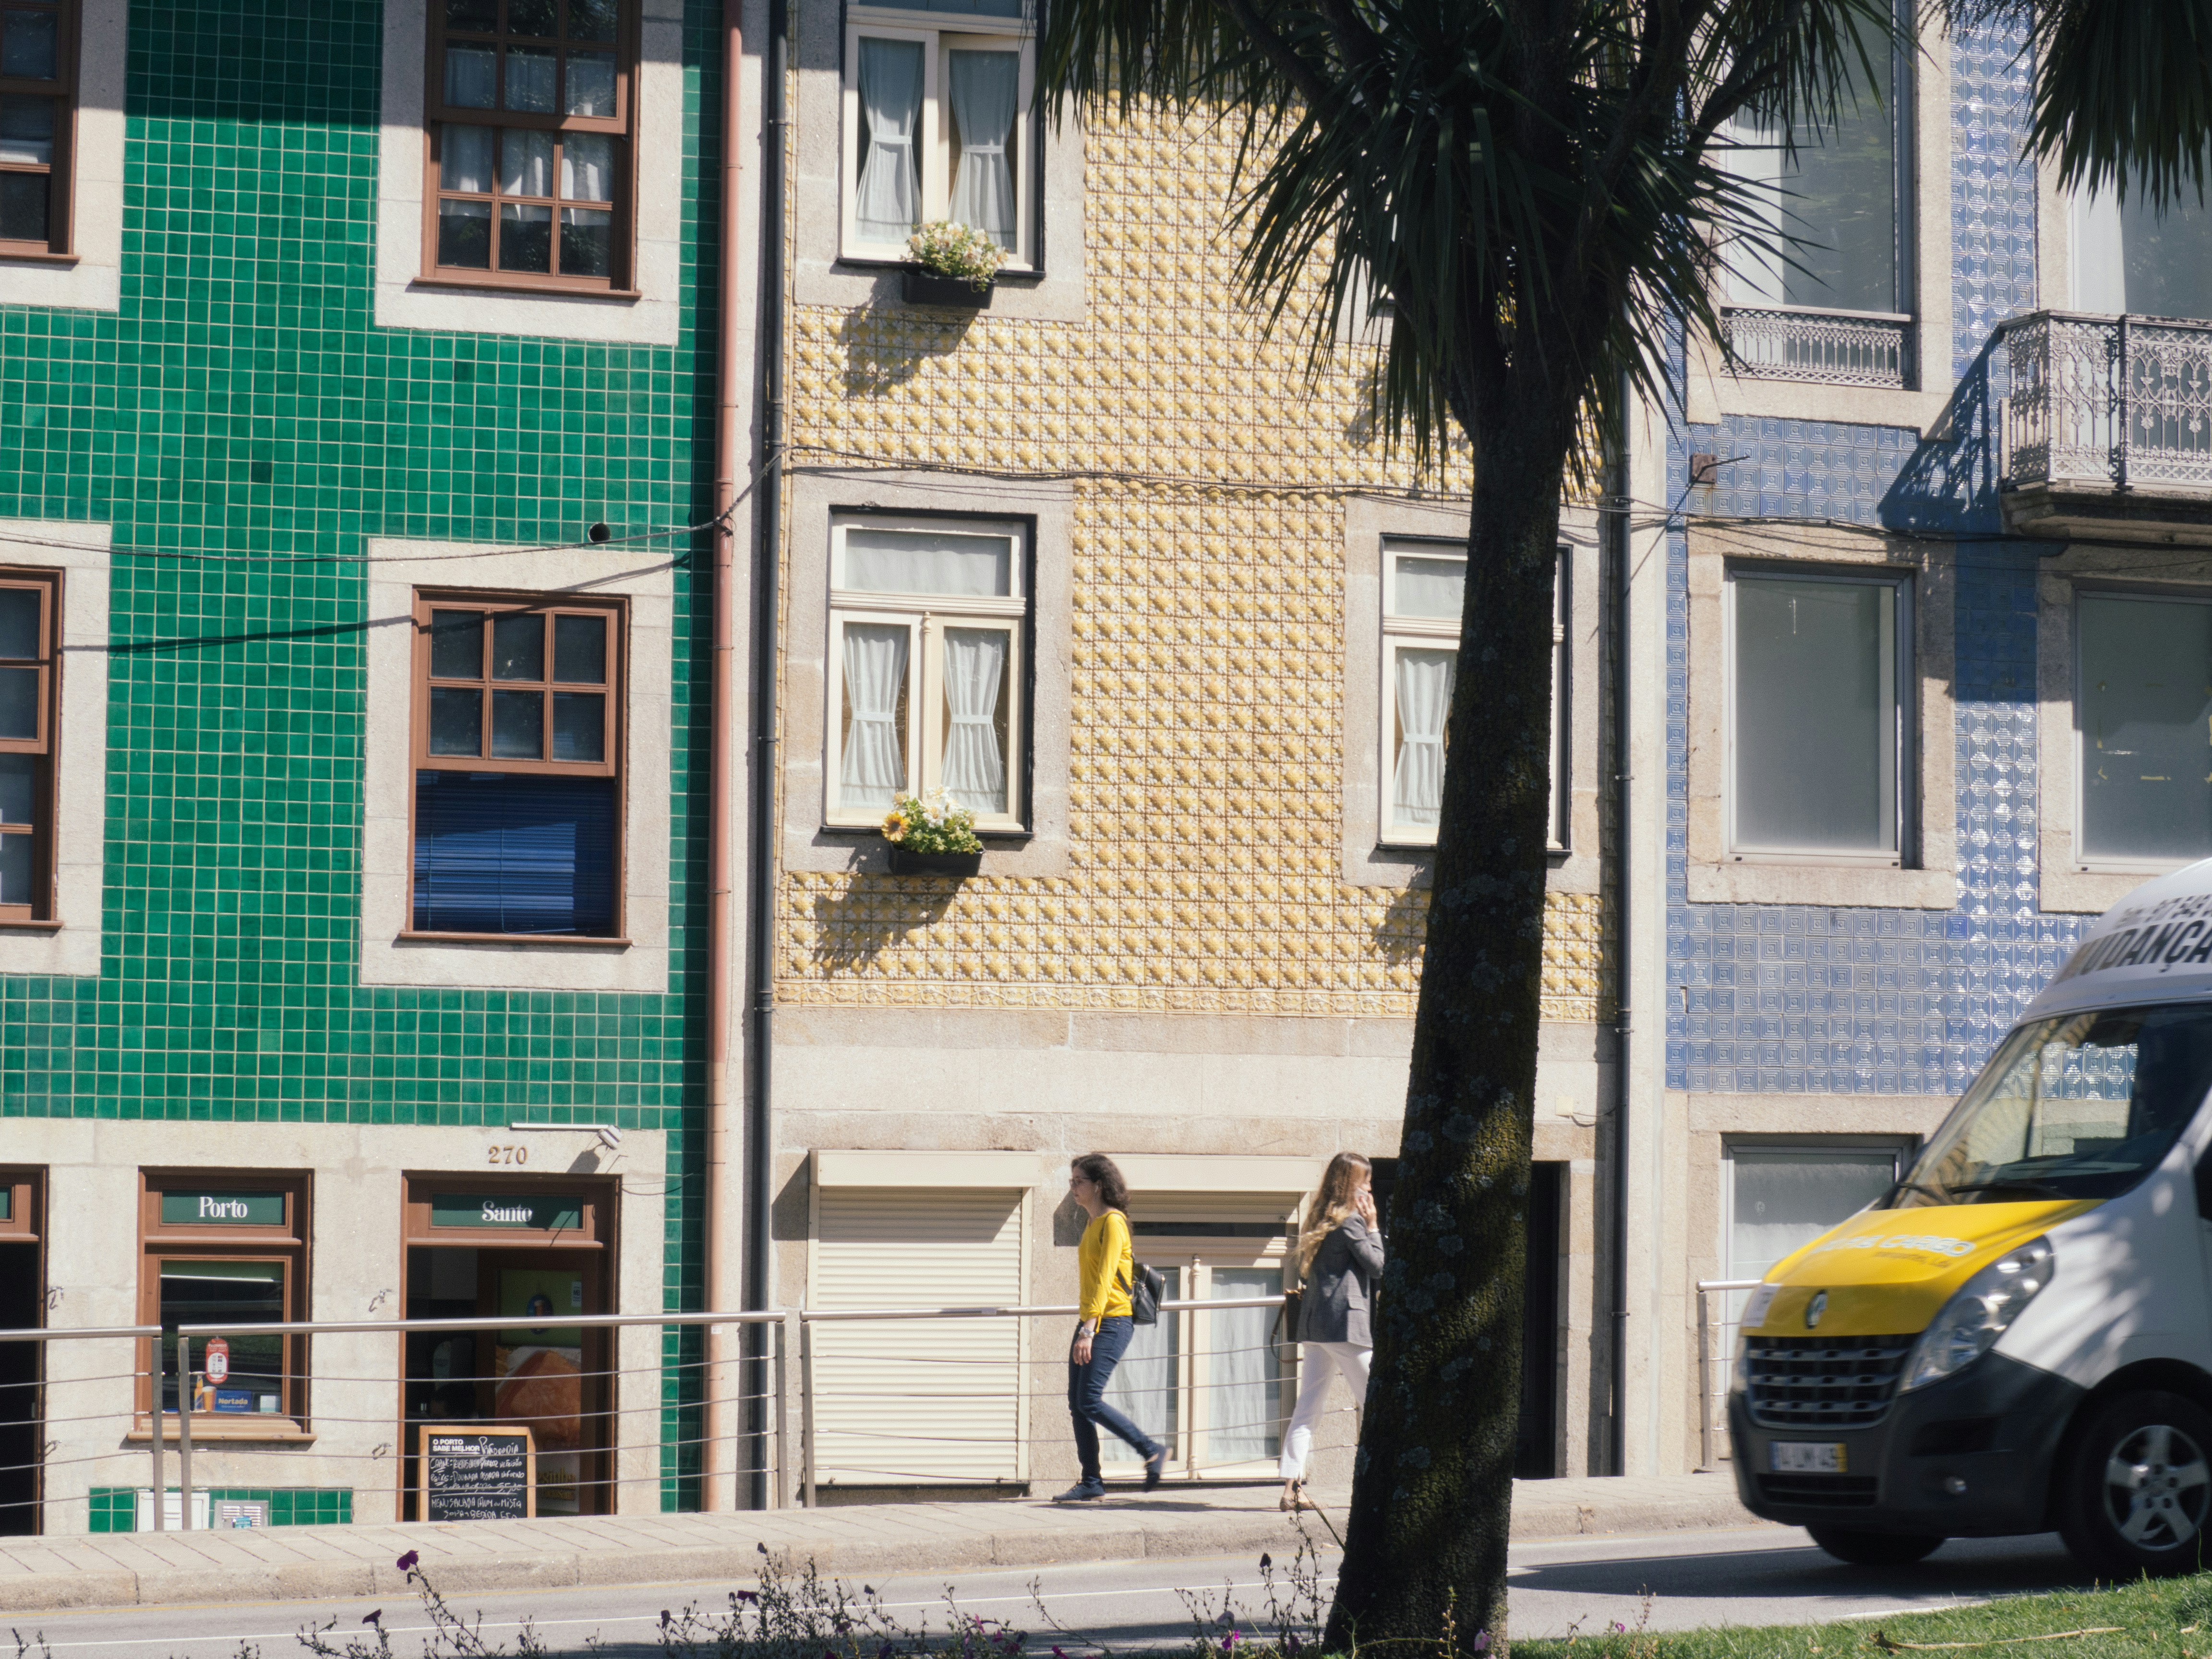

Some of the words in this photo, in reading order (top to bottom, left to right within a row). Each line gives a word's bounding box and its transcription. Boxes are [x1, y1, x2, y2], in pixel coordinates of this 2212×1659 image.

[489, 1144, 529, 1165] 270
[199, 1196, 248, 1218] Porto
[481, 1201, 533, 1222] Santo
